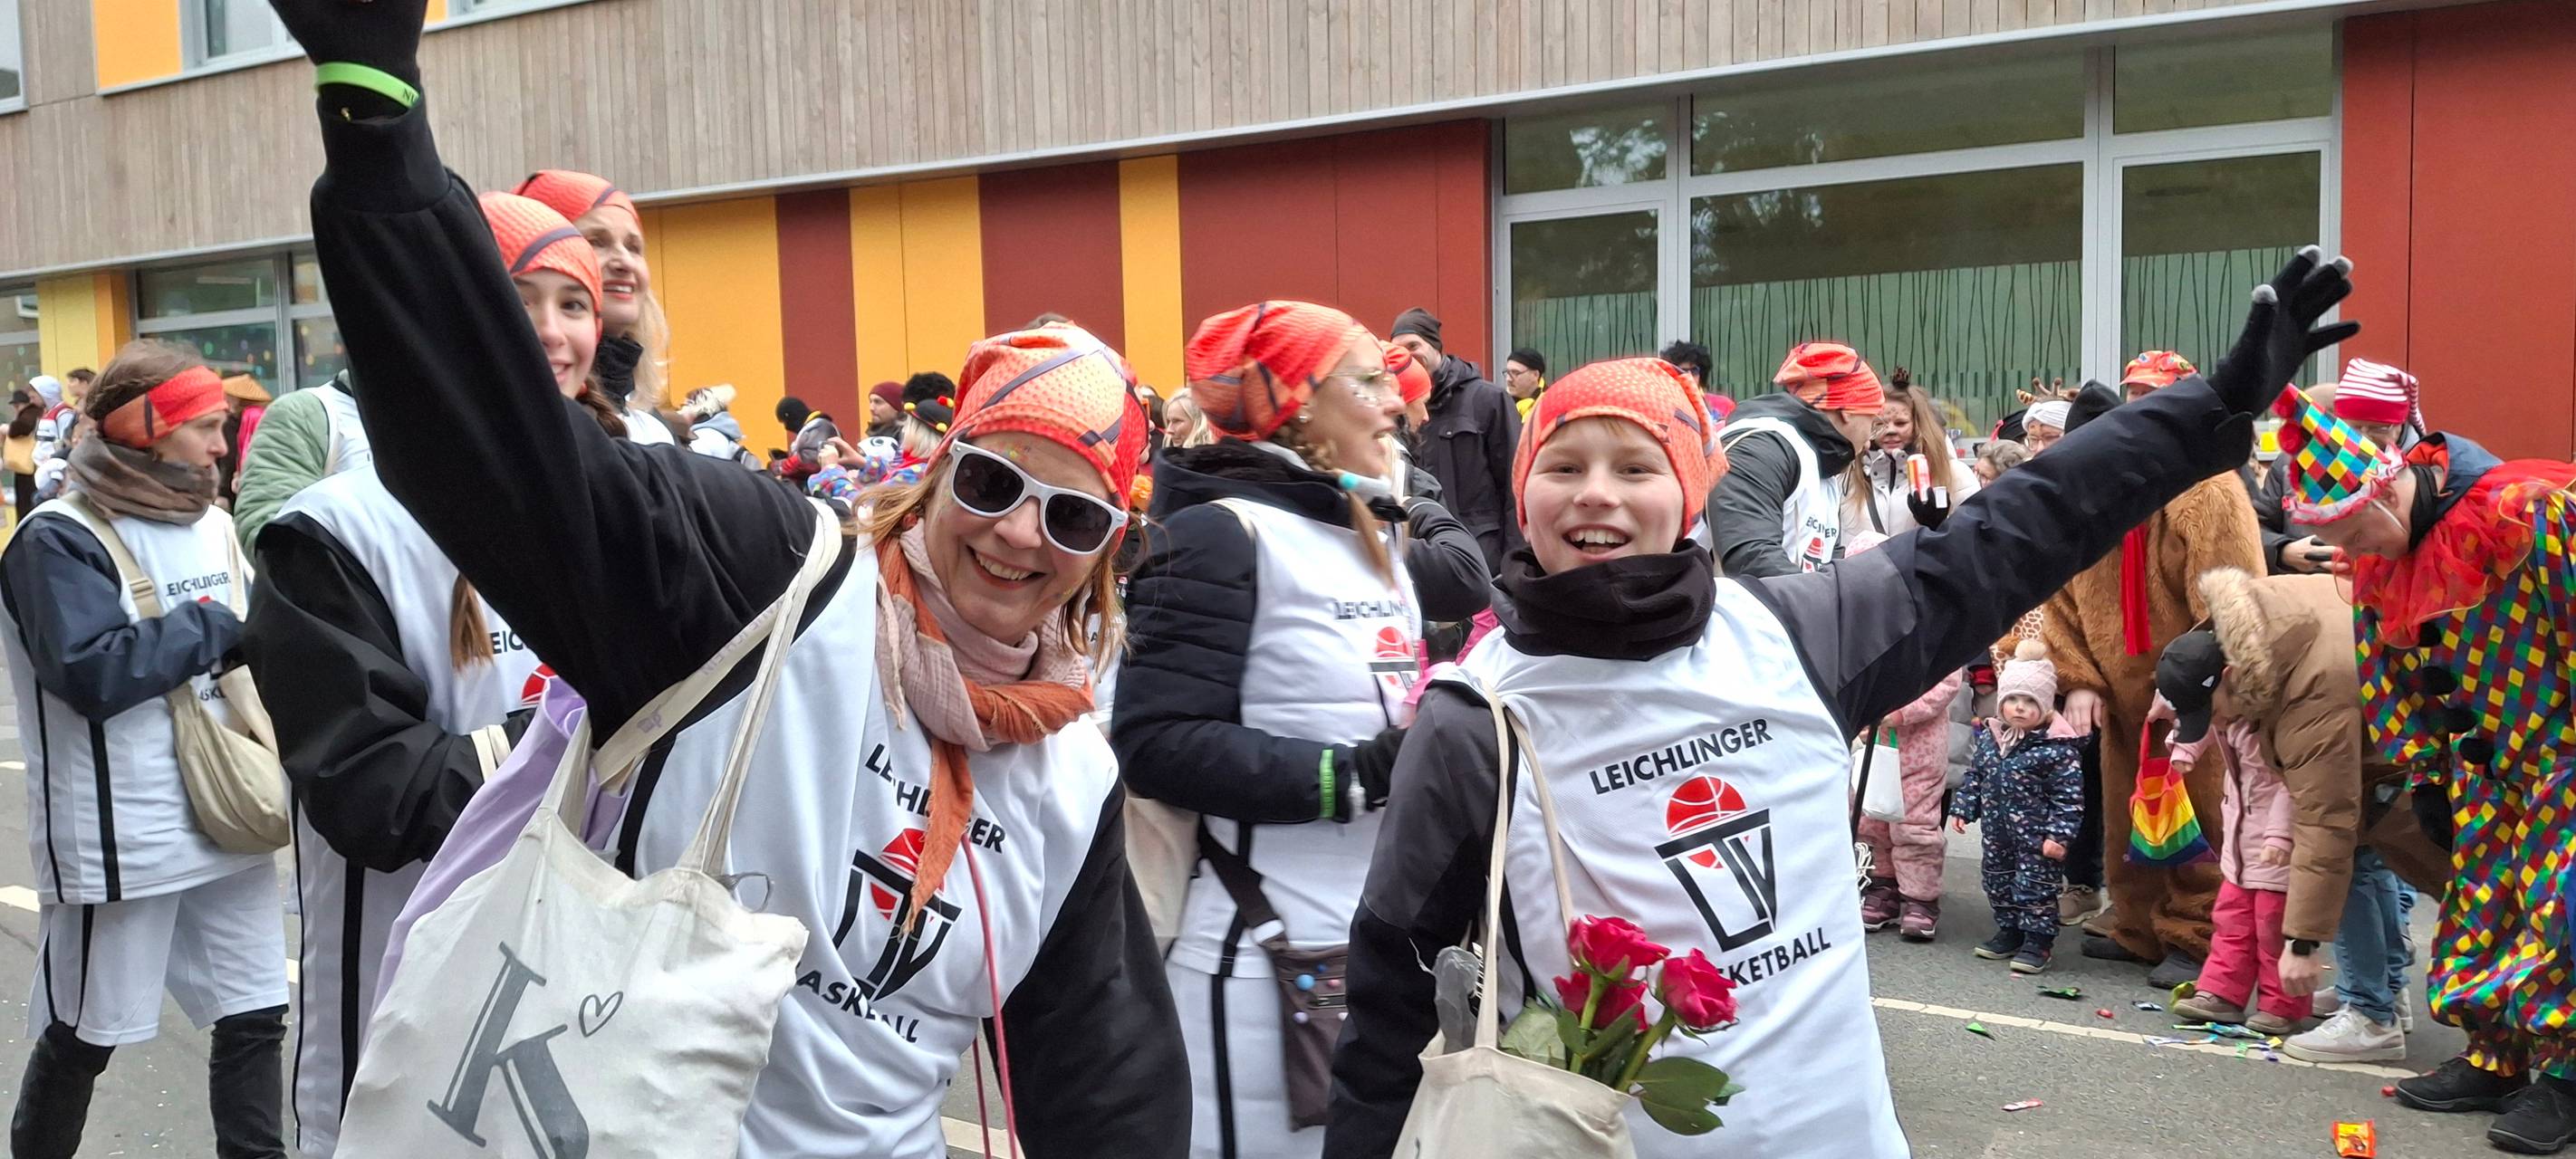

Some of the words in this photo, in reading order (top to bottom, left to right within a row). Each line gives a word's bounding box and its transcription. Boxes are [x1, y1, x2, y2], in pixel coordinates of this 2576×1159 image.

[1590, 719, 1773, 795] LEICHLINGER
[1717, 927, 1831, 986] KETBALL
[427, 941, 589, 1159] K
